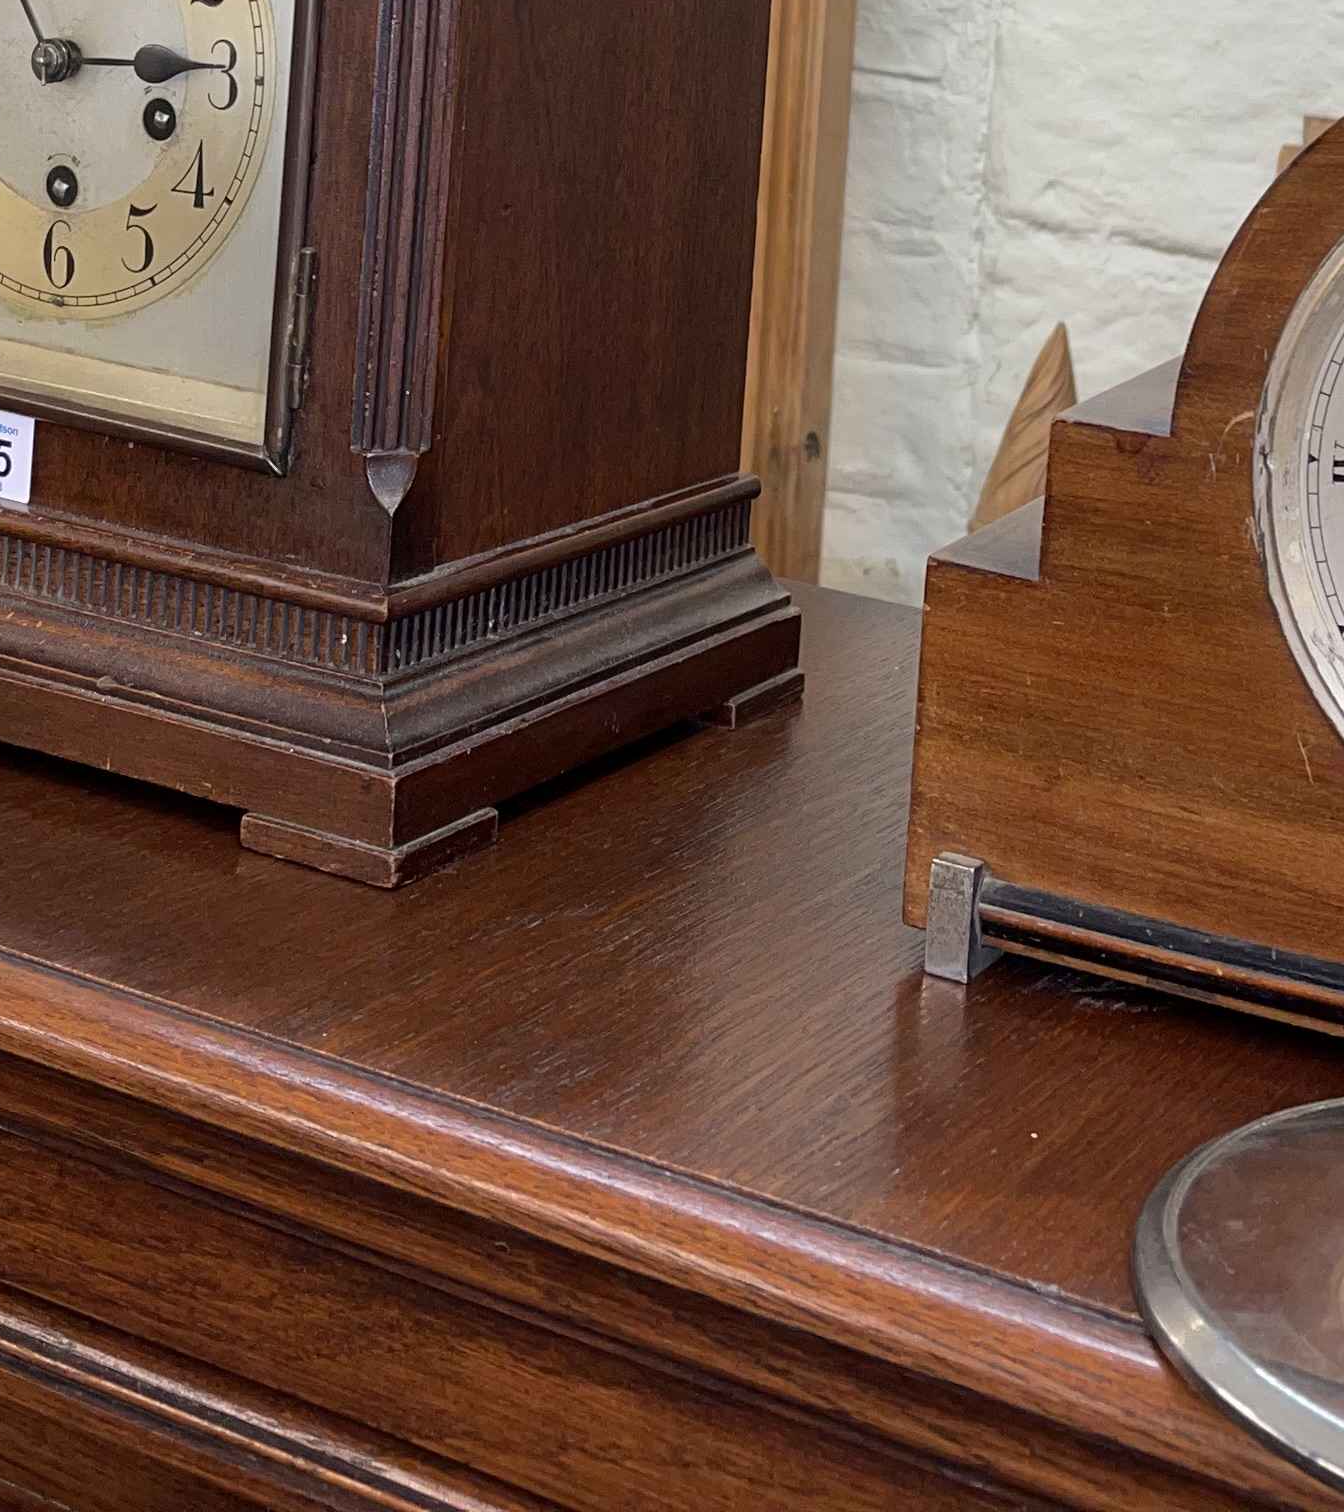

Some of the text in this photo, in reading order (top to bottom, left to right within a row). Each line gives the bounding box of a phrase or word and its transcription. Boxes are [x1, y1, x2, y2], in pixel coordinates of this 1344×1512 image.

[207, 39, 239, 110] 3
[171, 139, 215, 209] 4
[43, 219, 75, 289] 6
[121, 203, 158, 273] 5
